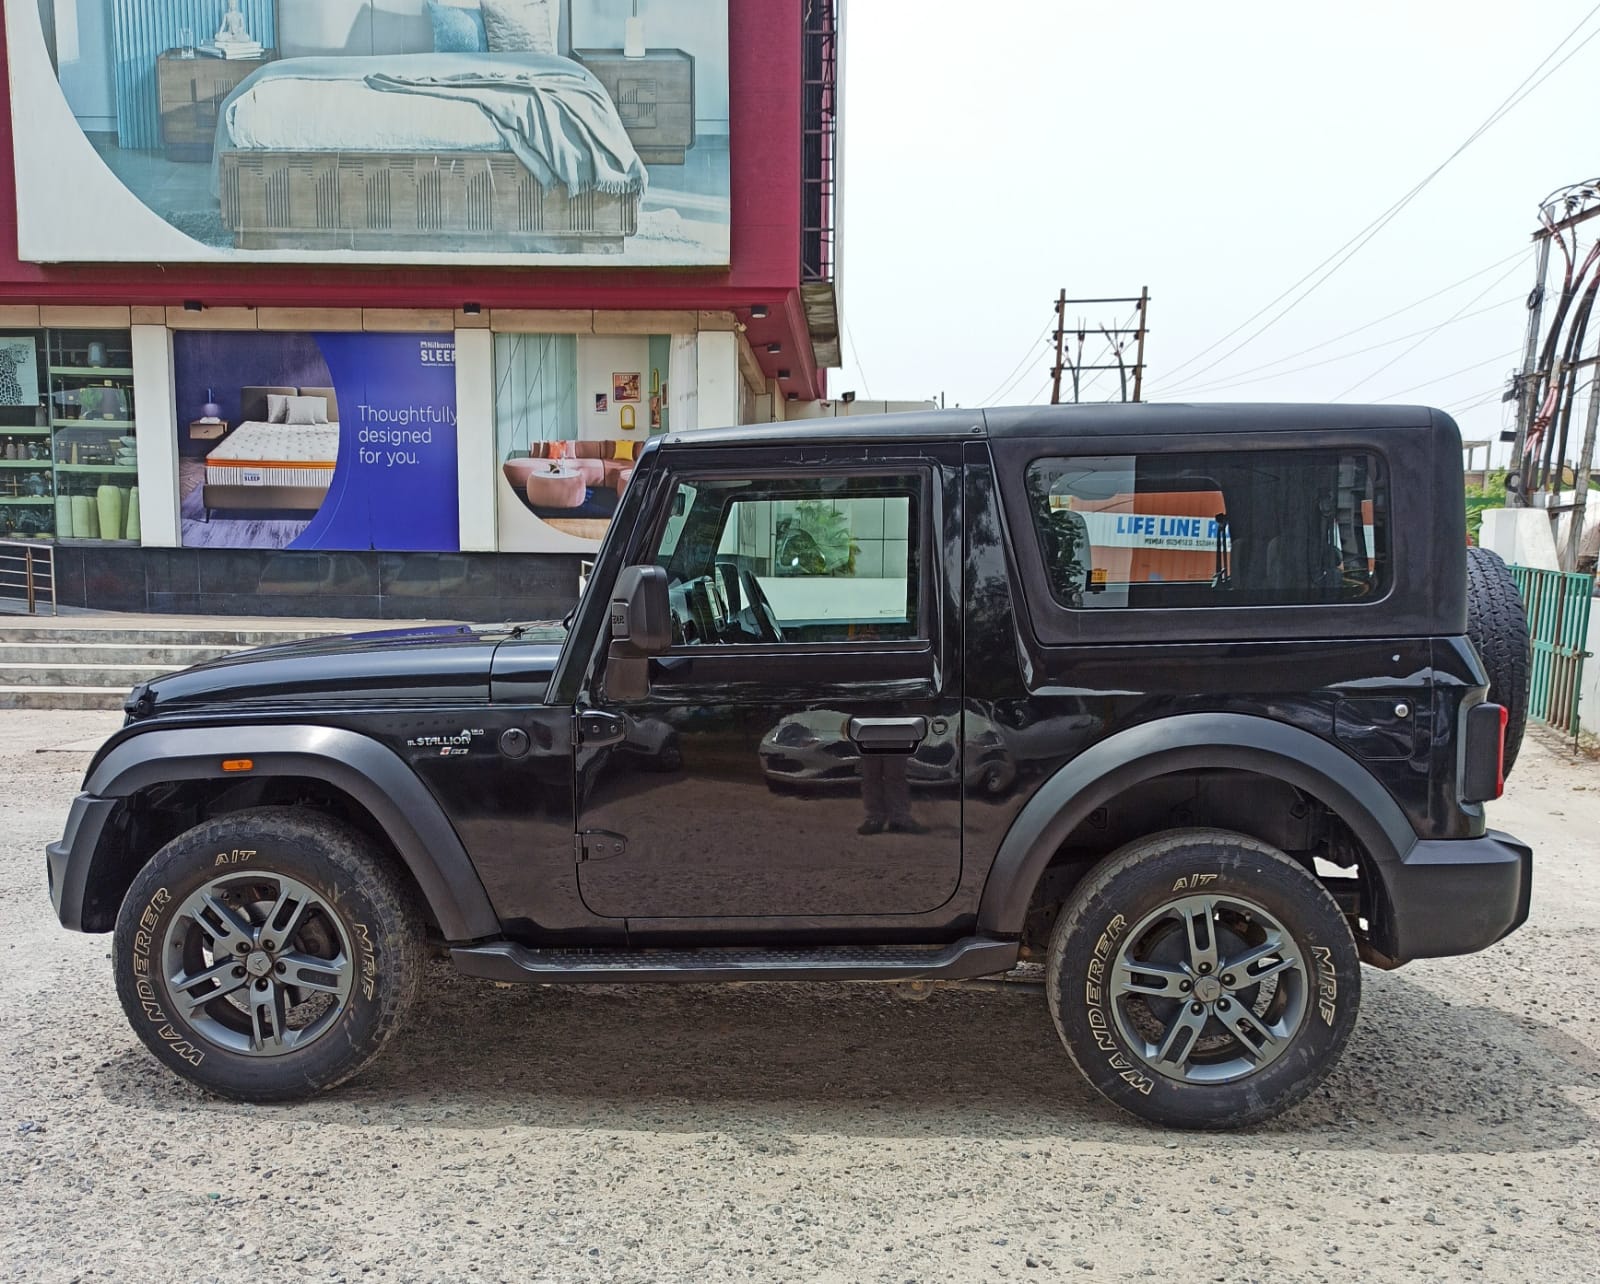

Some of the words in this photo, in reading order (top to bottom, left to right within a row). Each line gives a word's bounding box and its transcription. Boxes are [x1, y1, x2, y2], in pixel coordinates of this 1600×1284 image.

[357, 405, 457, 426] Thoughtfully
[358, 427, 432, 446] designed
[359, 447, 382, 464] for
[386, 451, 420, 467] you.
[1116, 516, 1155, 535] LIFE
[1160, 518, 1201, 538] LINE
[133, 887, 206, 1066] WANDERER
[353, 923, 375, 1001] MRF
[1311, 945, 1337, 1027] MRF
[1086, 913, 1154, 1095] WANDERER
